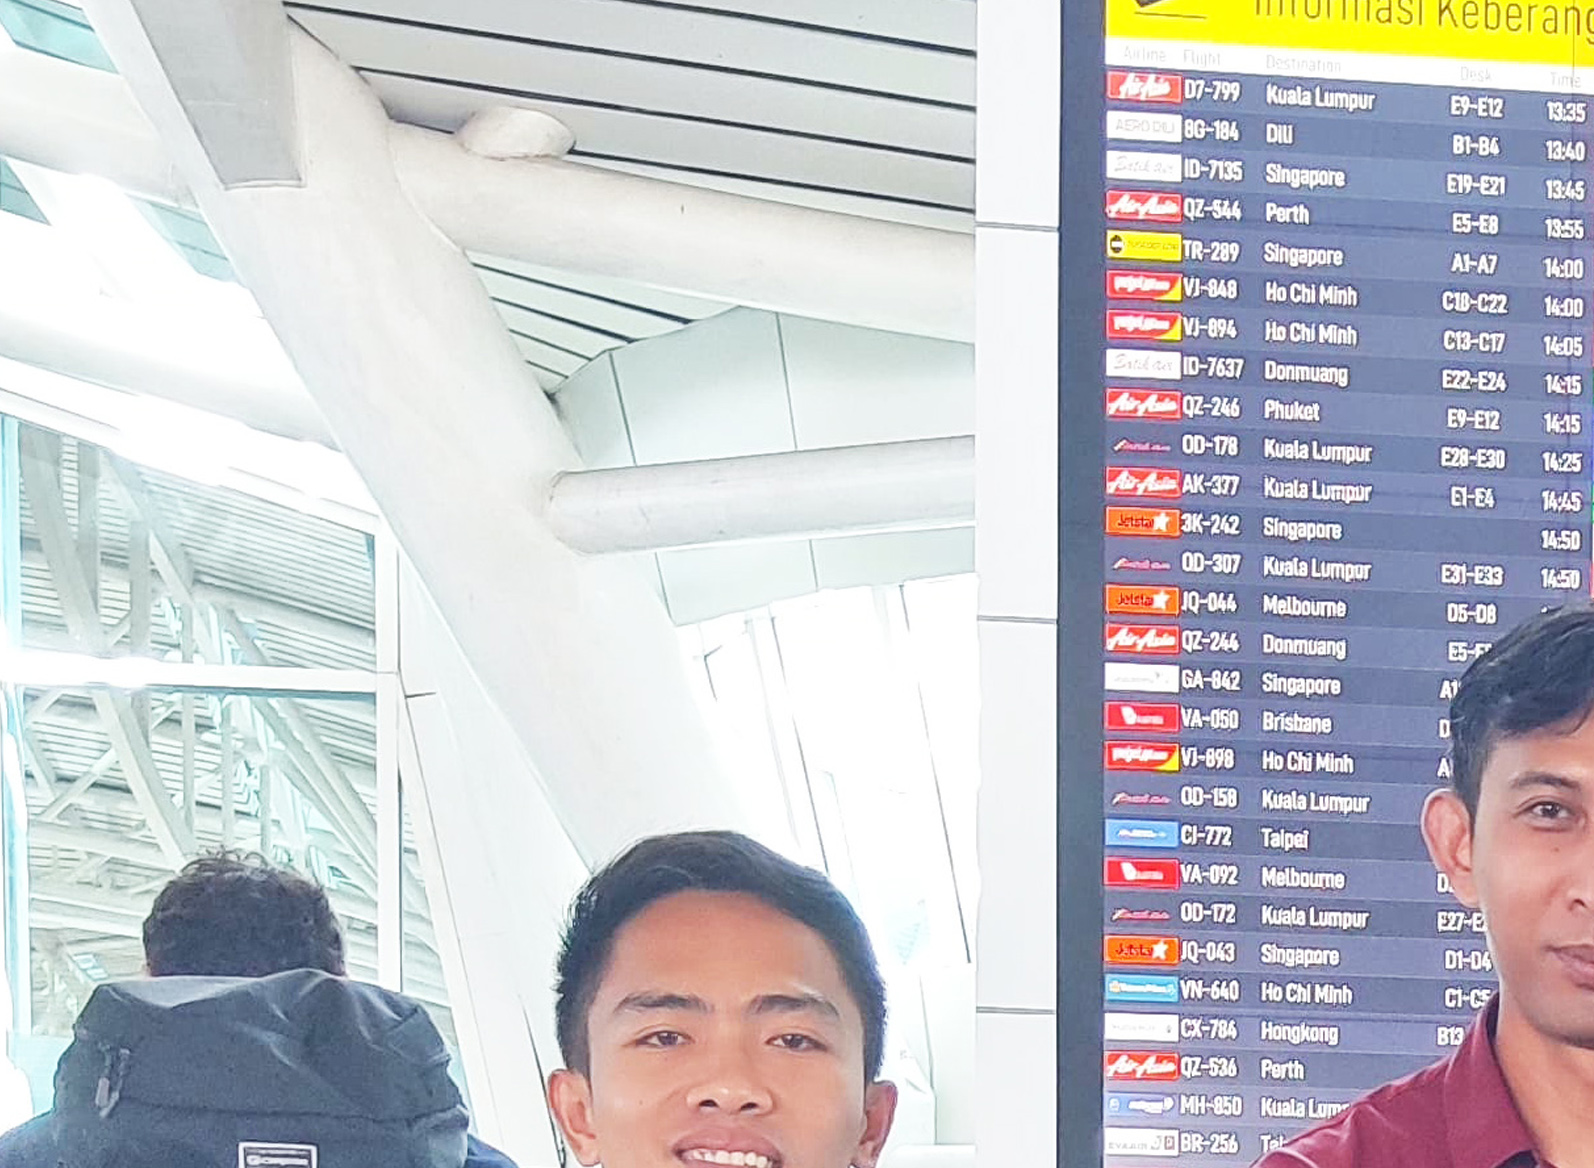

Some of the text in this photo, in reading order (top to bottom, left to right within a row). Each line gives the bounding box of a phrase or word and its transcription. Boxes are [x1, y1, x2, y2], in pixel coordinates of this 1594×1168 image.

[1550, 71, 1582, 89] Time
[1185, 80, 1240, 101] D7-799
[1267, 84, 1311, 105] Kuala
[1315, 88, 1375, 112] Lumpur
[1547, 102, 1586, 122] 13:35
[1185, 119, 1239, 140] 8G-184
[1267, 124, 1292, 143] Dili
[1546, 141, 1585, 161] 13:40
[1185, 159, 1242, 181] ID-7135
[1266, 163, 1345, 189] Singapore
[1546, 180, 1584, 200] 13:45
[1184, 198, 1241, 221] QZ-544
[1266, 203, 1309, 224] Perth
[1545, 219, 1583, 239] 13:55
[1183, 240, 1239, 261] TR-289
[1264, 242, 1343, 267] Singapore
[1543, 258, 1583, 278] 14:00
[1184, 276, 1237, 298] VJ-848
[1266, 282, 1286, 301] Ho
[1290, 283, 1315, 303] Chi
[1319, 284, 1357, 306] Minh
[1545, 296, 1583, 317] 14:00
[1184, 317, 1237, 338] VJ-894
[1265, 321, 1286, 342] Ho
[1290, 323, 1315, 342] Chi
[1319, 324, 1356, 345] Minh
[1544, 336, 1582, 356] 14:05
[1265, 361, 1348, 387] Donmuang
[1265, 400, 1319, 420] Phuket
[1265, 439, 1309, 459] Kuala
[1312, 441, 1372, 464] Lumpur
[1264, 475, 1308, 498] Kuala
[1312, 480, 1372, 503] Lumpur
[1264, 517, 1342, 541] Singapore
[1264, 556, 1308, 576] Kuala
[1312, 558, 1371, 582] Lumpur
[1264, 595, 1346, 617] Melbourne
[1263, 634, 1346, 660] Donmuang
[1263, 673, 1340, 697] Singapore
[1263, 711, 1331, 734] Brisbane
[1263, 750, 1353, 773] Ho Chi Minh
[1262, 790, 1370, 816] Kuala Lumpur
[1261, 828, 1309, 851] Taipei
[1262, 867, 1344, 889] Melbourne
[1262, 905, 1369, 929] Kuala Lumpur
[1261, 944, 1339, 967] Singapore
[1262, 982, 1352, 1005] Ho Chi Minh
[1262, 1021, 1338, 1045] Hongkong
[1262, 1059, 1304, 1080] Perth
